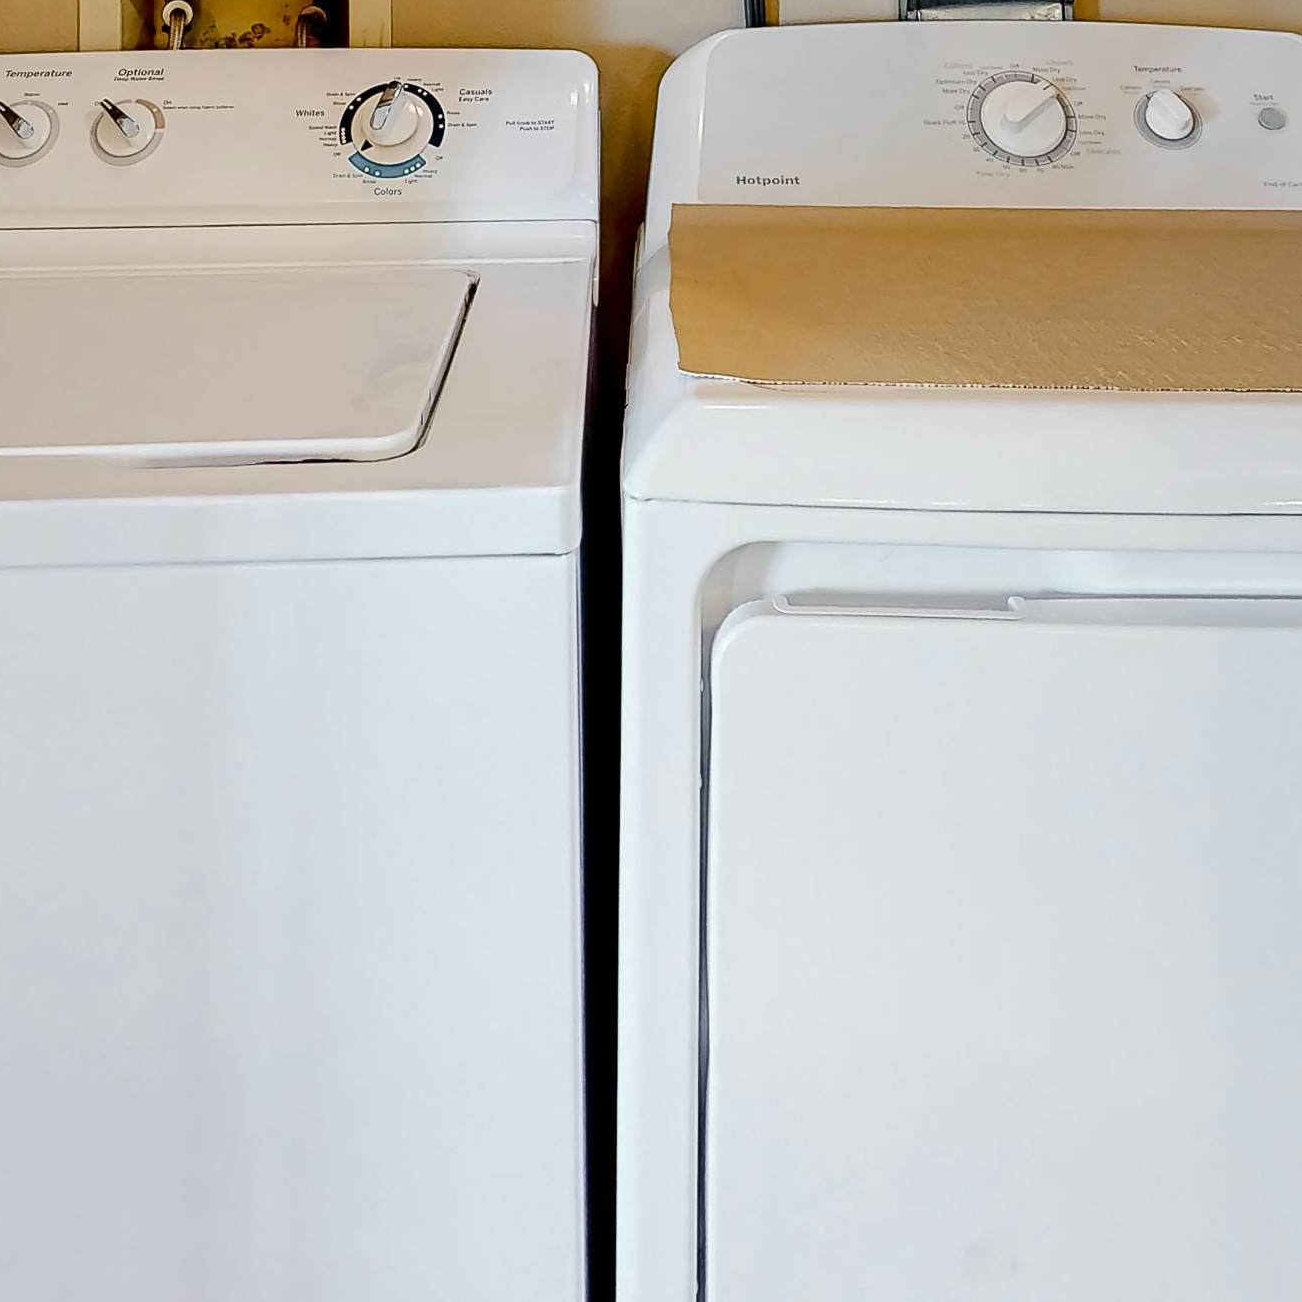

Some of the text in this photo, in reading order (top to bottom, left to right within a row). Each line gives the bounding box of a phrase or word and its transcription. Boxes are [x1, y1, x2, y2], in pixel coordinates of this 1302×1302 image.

[5, 69, 73, 79] Temperature
[118, 68, 165, 78] Optional
[1133, 65, 1182, 74] Temperature
[459, 88, 493, 96] Casuals
[295, 109, 326, 117] Whites
[736, 174, 801, 187] Hotpoint
[373, 187, 403, 196] Colors
